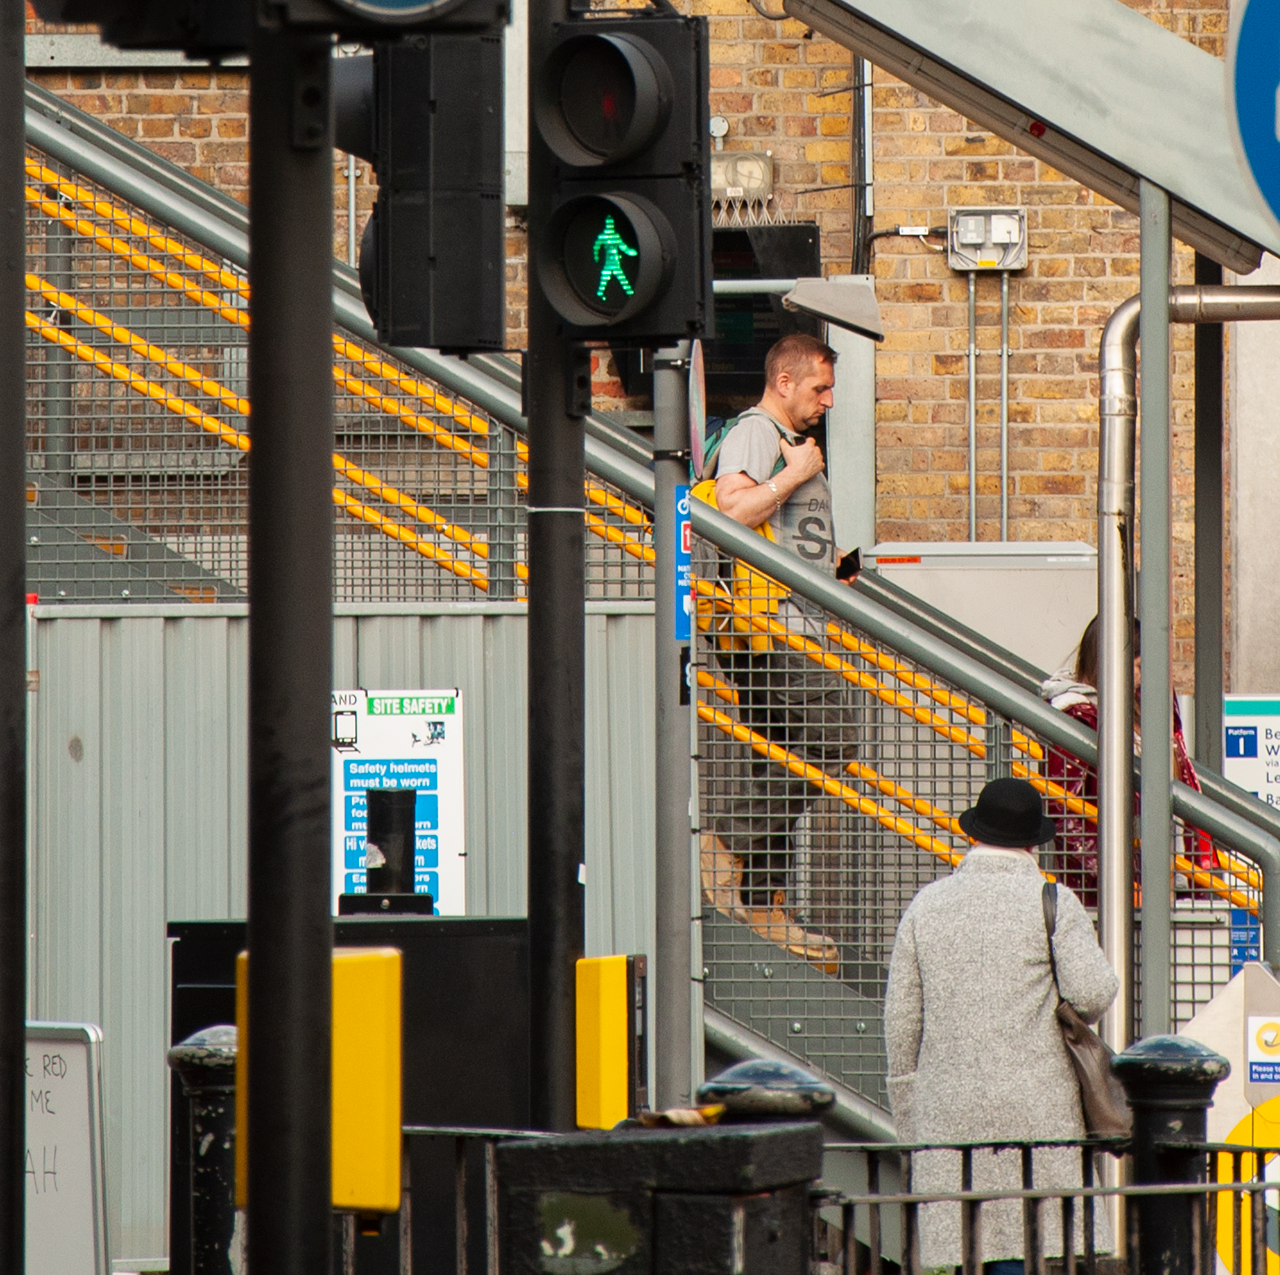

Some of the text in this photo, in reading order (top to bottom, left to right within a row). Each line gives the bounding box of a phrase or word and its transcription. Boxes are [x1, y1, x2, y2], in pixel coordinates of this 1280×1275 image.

[373, 698, 447, 714] SITE SAFETY
[1228, 728, 1255, 736] Platform
[1239, 737, 1244, 755] 1
[349, 762, 437, 776] Safety helmets
[1265, 759, 1279, 767] via
[350, 776, 430, 787] must be worn
[415, 821, 431, 829] orn
[346, 836, 357, 851] Hi
[415, 836, 437, 850] kets
[352, 874, 367, 883] Ea
[42, 1054, 67, 1078] RED
[1252, 1065, 1274, 1073] Please
[31, 1090, 55, 1115] ME
